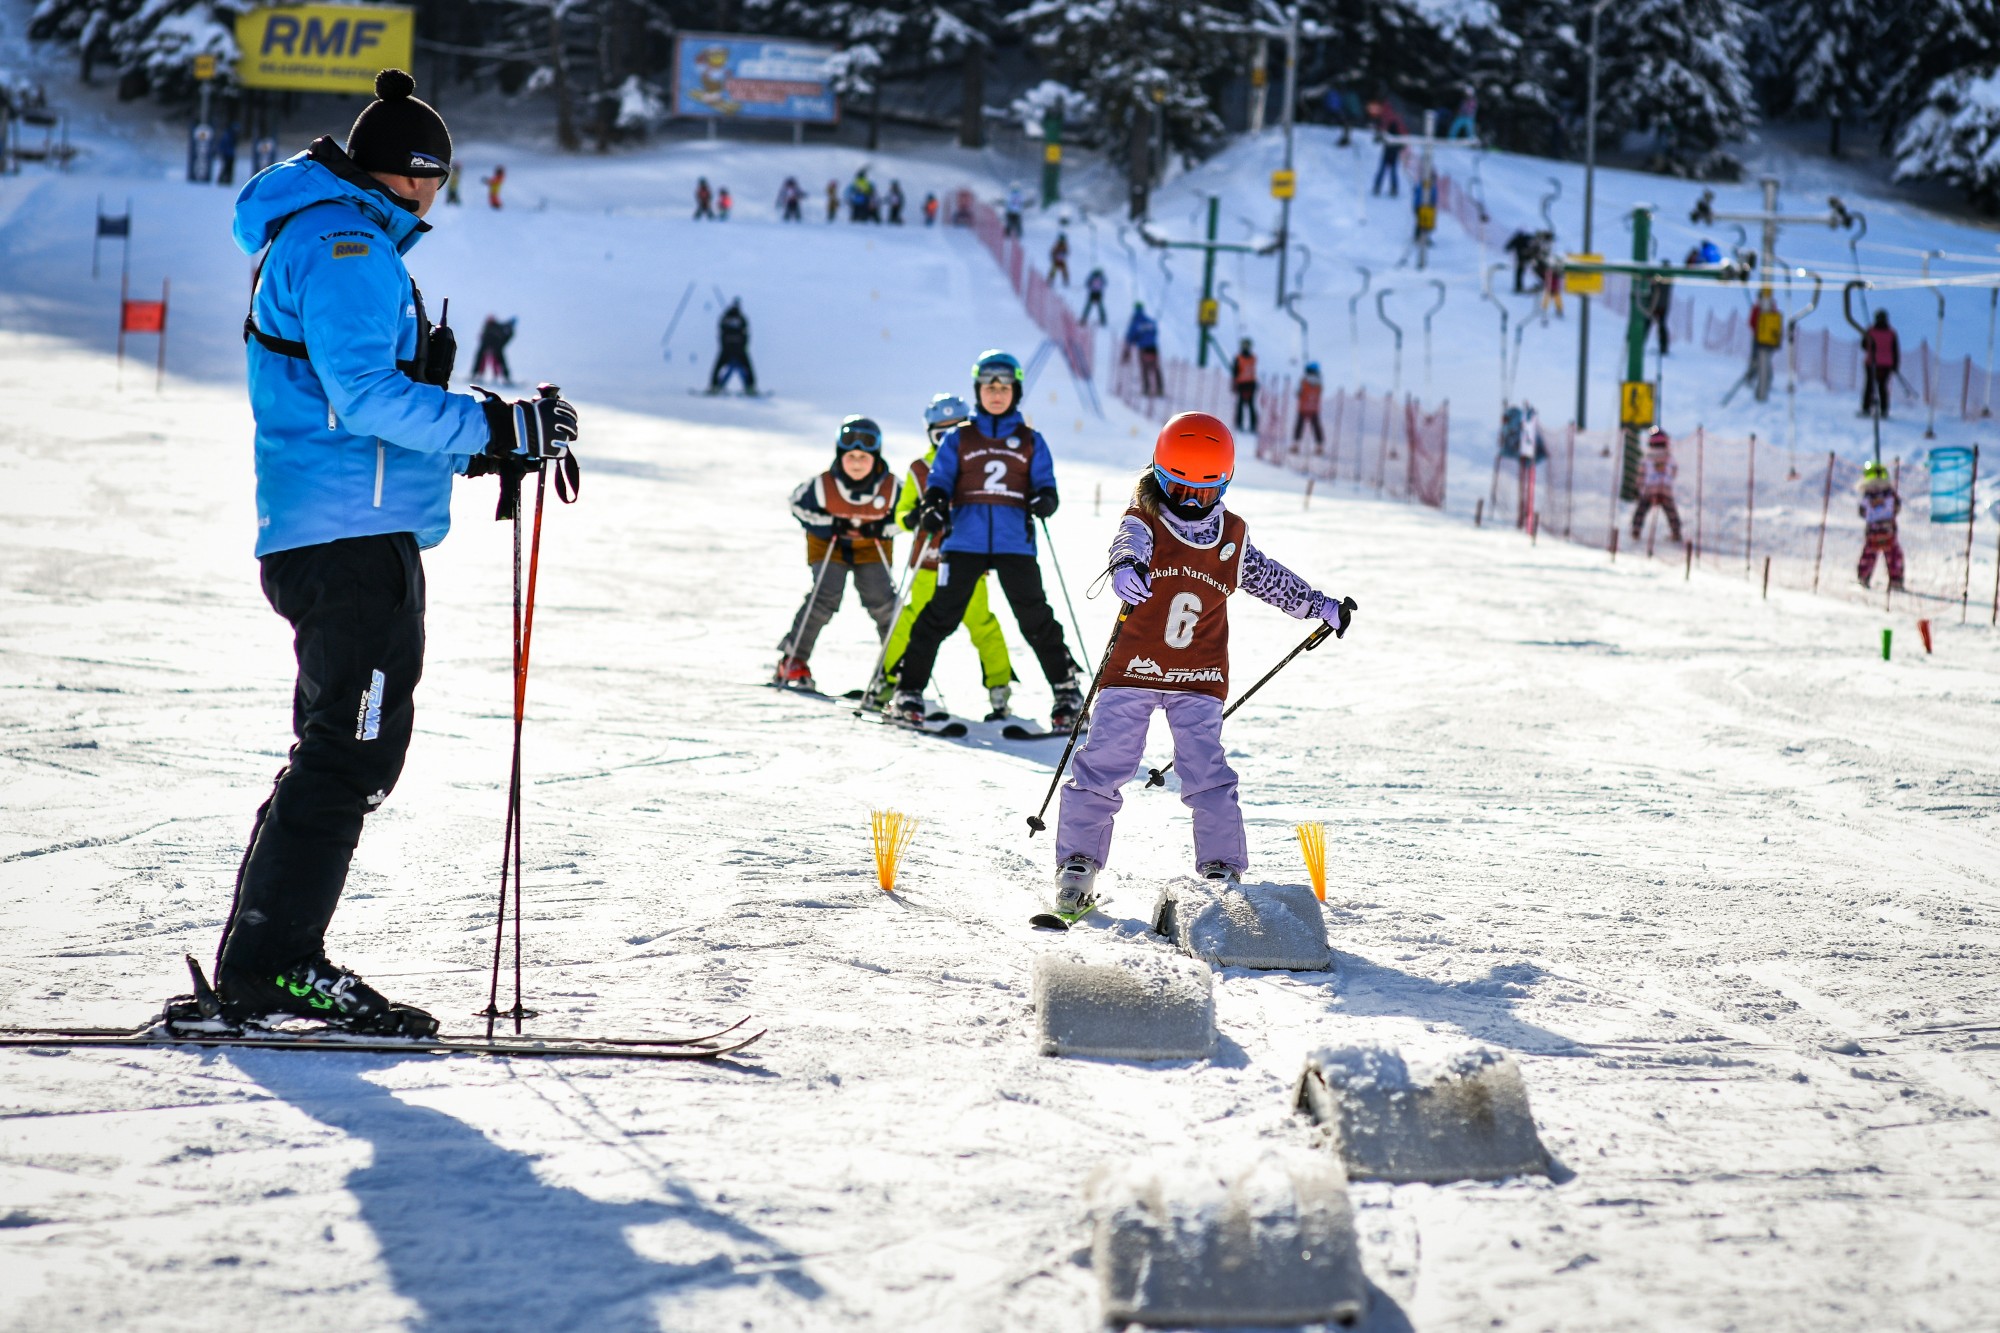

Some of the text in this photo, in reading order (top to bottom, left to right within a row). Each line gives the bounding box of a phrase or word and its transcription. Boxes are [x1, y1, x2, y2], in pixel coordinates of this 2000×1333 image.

[261, 14, 386, 56] RMF
[335, 244, 368, 255] RMF
[983, 460, 1007, 491] 2
[1150, 566, 1232, 597] zkoła Narciarska
[1164, 591, 1203, 650] 6
[1123, 670, 1225, 683] Zakopane STRAMA
[355, 690, 369, 740] Zakopane
